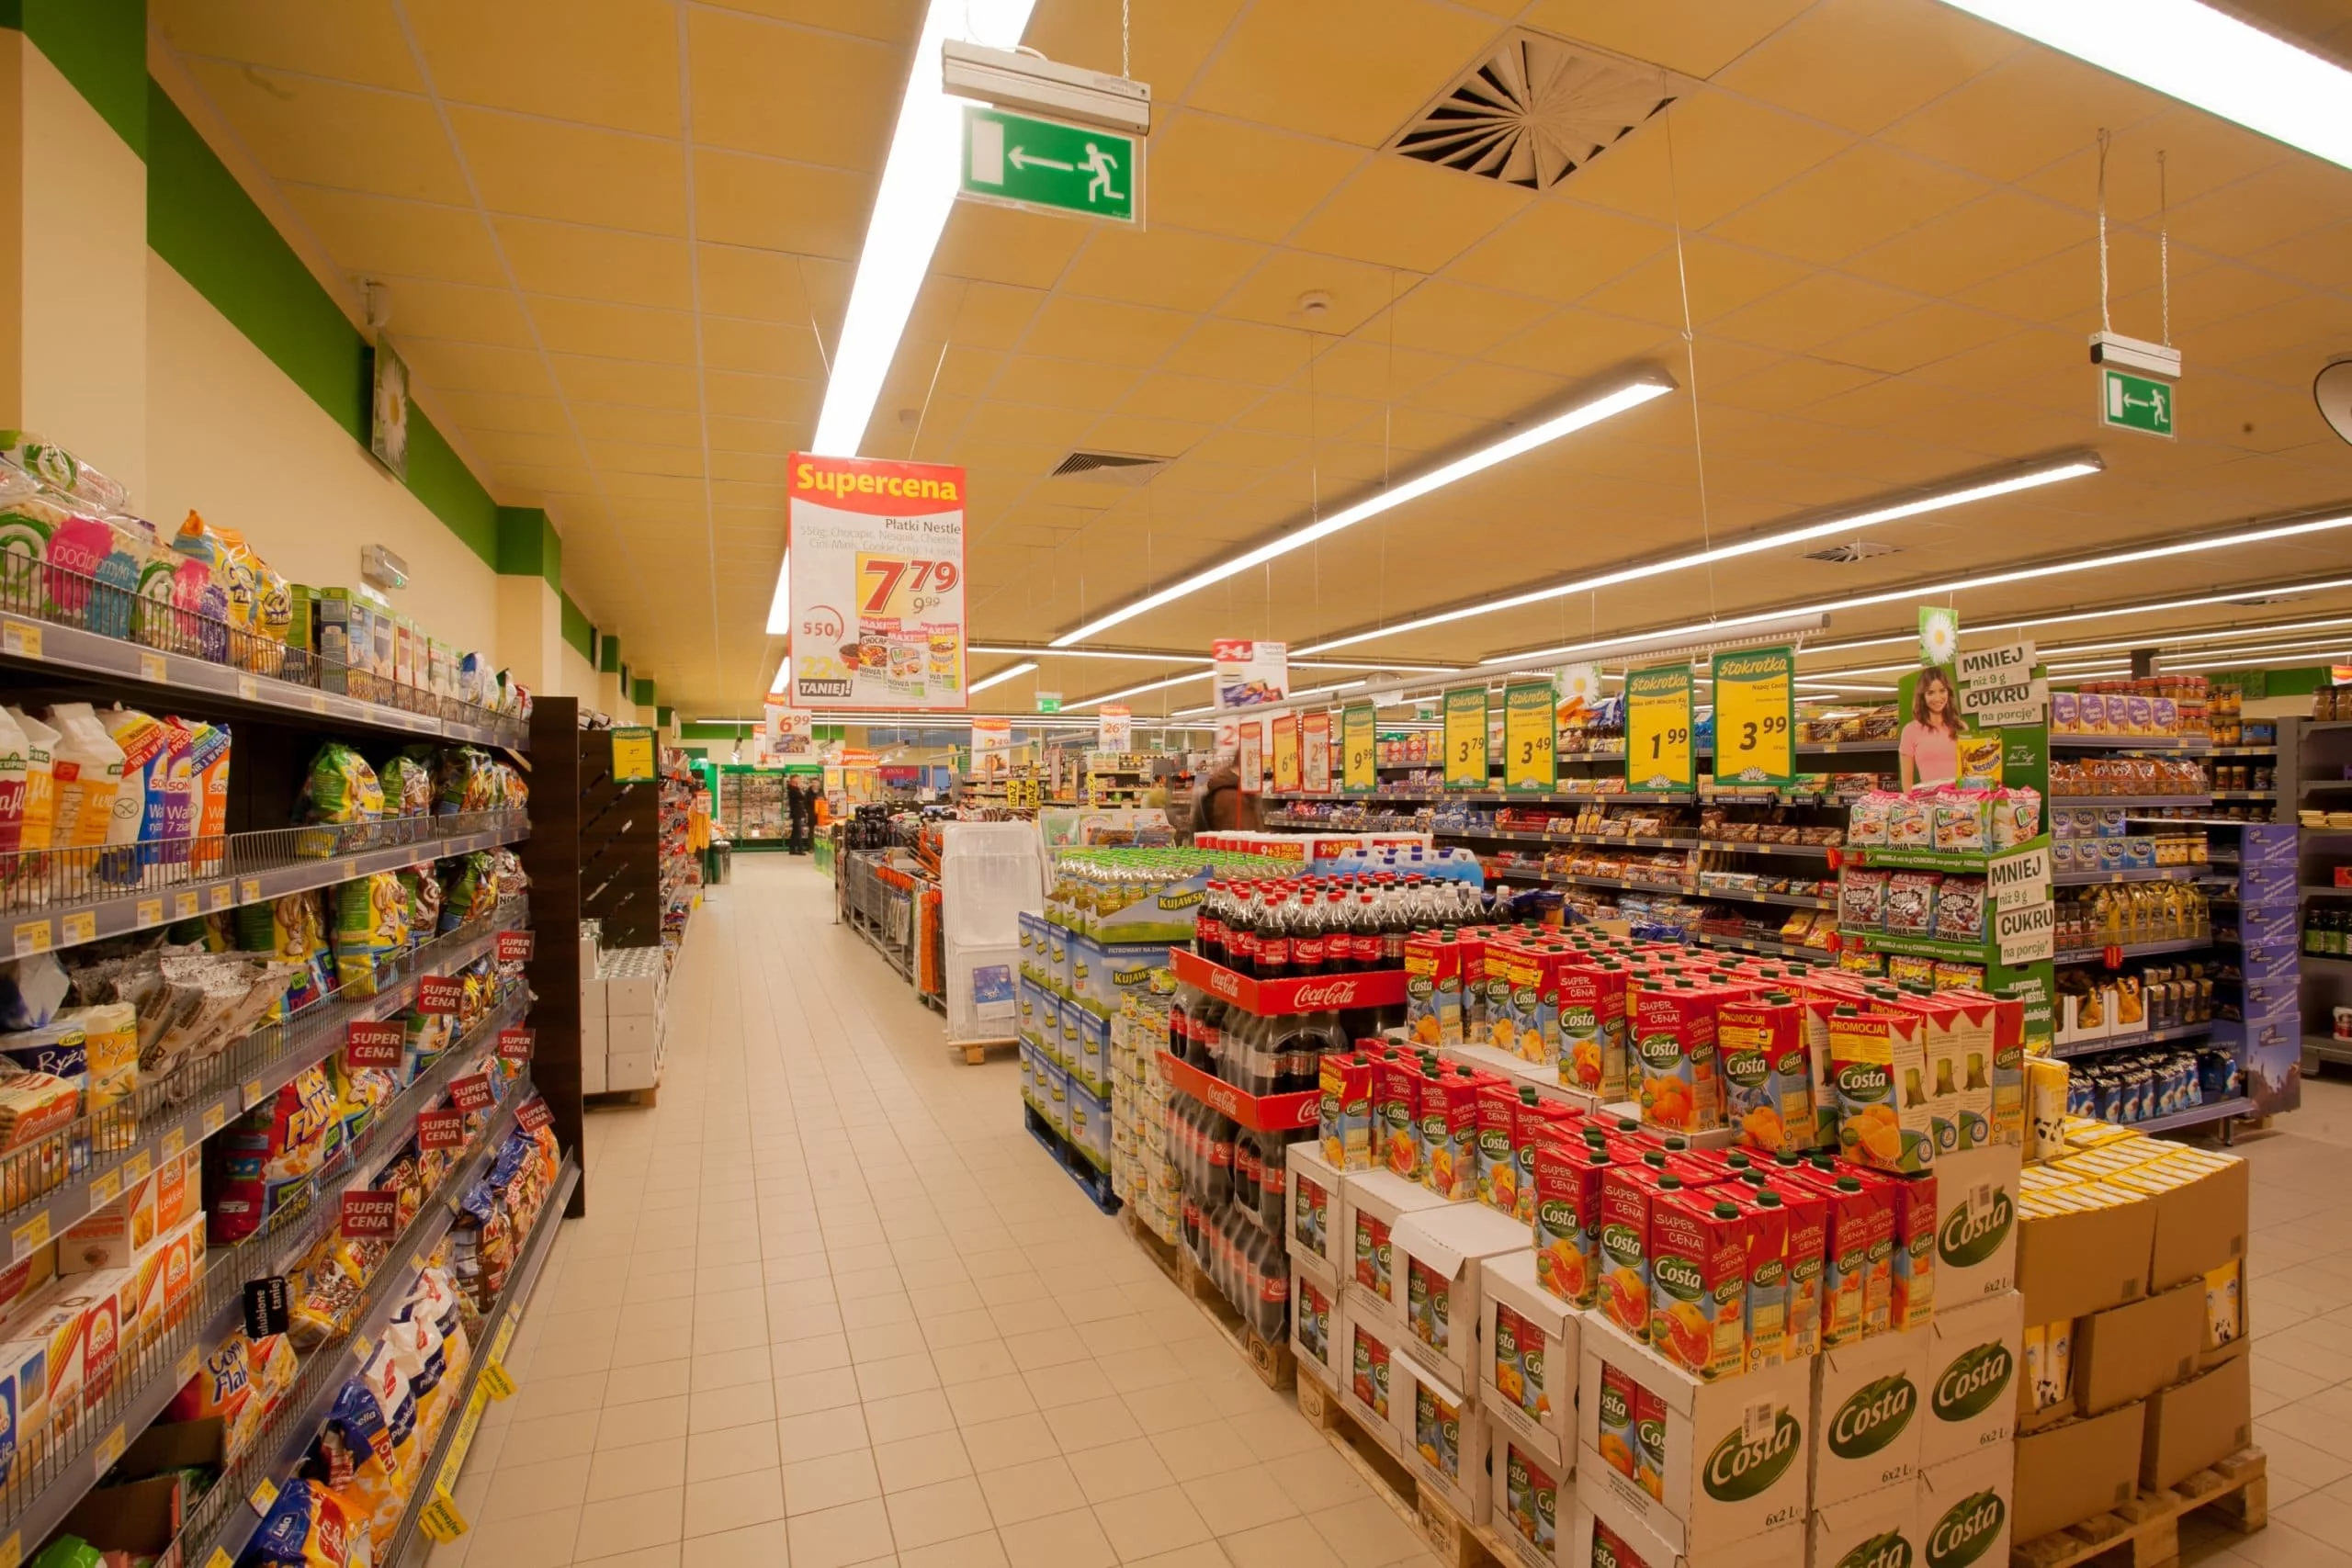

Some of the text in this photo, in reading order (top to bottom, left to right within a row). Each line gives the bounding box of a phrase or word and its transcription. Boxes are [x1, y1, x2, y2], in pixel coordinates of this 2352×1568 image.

[797, 463, 957, 501] Supercena
[886, 518, 961, 535] Płatki Nestle
[1719, 656, 1787, 677] Stokrotka
[1962, 647, 2023, 673] MNIEJ
[1631, 673, 1688, 692] Stokrotka
[1973, 673, 2007, 685] niż 9 g
[799, 680, 853, 695] TANIEJ!
[1449, 694, 1486, 707] Stokrotka
[1508, 690, 1552, 705] Stokrotka
[1966, 686, 2030, 708] CUKRU
[1981, 712, 1994, 720] na
[1991, 856, 2041, 886] MNIEJ
[1159, 889, 1204, 908] KUJAWSK
[1999, 891, 2029, 905] niż 9 g
[2001, 907, 2053, 936] CUKRU
[500, 938, 530, 947] SUPER
[502, 946, 526, 955] CENA
[2004, 946, 2014, 958] na
[1408, 978, 1433, 993] Costa
[1440, 977, 1459, 991] Costa
[1487, 981, 1510, 996] Costa
[1561, 976, 1590, 987] SUPER
[422, 985, 462, 997] SUPER
[1514, 989, 1536, 1006] Costa
[424, 997, 457, 1008] CENA
[1639, 1001, 1673, 1011] SUPER
[1561, 1010, 1596, 1028] Costa
[1604, 1019, 1625, 1032] Costa
[1650, 1014, 1680, 1023] CENA!
[1719, 1011, 1766, 1026] PROMOCJA!
[1830, 1021, 1887, 1035] PROMOCJA!
[352, 1032, 401, 1044] SUPER
[502, 1036, 531, 1045] SUPER
[355, 1046, 395, 1058] CENA
[503, 1043, 527, 1053] CENA
[1642, 1040, 1679, 1057] Costa
[1690, 1045, 1714, 1061] Costa
[1778, 1055, 1802, 1070] Costa
[1996, 1049, 2020, 1064] Costa
[1726, 1056, 1766, 1075] Costa
[1839, 1069, 1886, 1089] Costa
[454, 1081, 488, 1099] SUPER
[460, 1091, 489, 1106] CENA
[1320, 1098, 1340, 1112] Costa
[1477, 1100, 1505, 1110] SUPER
[520, 1104, 547, 1121] SUPER
[1346, 1100, 1368, 1113] Costa
[1386, 1106, 1410, 1120] Costa
[421, 1119, 460, 1131] SUPER
[526, 1112, 548, 1126] CENA
[1423, 1120, 1447, 1135] Costa
[1455, 1128, 1476, 1142] Costa
[425, 1130, 458, 1142] CENA
[1480, 1134, 1510, 1150] Costa
[1540, 1164, 1574, 1179] SUPER
[1551, 1179, 1579, 1193] CENA!
[1605, 1186, 1640, 1203] SUPER
[345, 1202, 394, 1214] SUPER
[1541, 1203, 1577, 1227] Costa
[1615, 1202, 1645, 1220] CENA!
[347, 1217, 389, 1228] CENA
[1655, 1214, 1697, 1233] SUPER
[1944, 1201, 2007, 1251] Costa
[1604, 1227, 1641, 1256] Costa
[1668, 1233, 1704, 1250] CENA!
[1910, 1234, 1933, 1254] Costa
[1869, 1241, 1892, 1259] Costa
[1839, 1252, 1864, 1270] Costa
[1657, 1260, 1702, 1289] Costa
[1755, 1262, 1782, 1282] Costa
[1793, 1259, 1821, 1279] Costa
[268, 1279, 283, 1310] taniej
[1715, 1280, 1743, 1301] Costa
[1938, 1352, 2007, 1407] Costa
[1836, 1385, 1910, 1444] Costa
[1712, 1423, 1792, 1486] Costa
[1931, 1500, 1998, 1559] Costa
